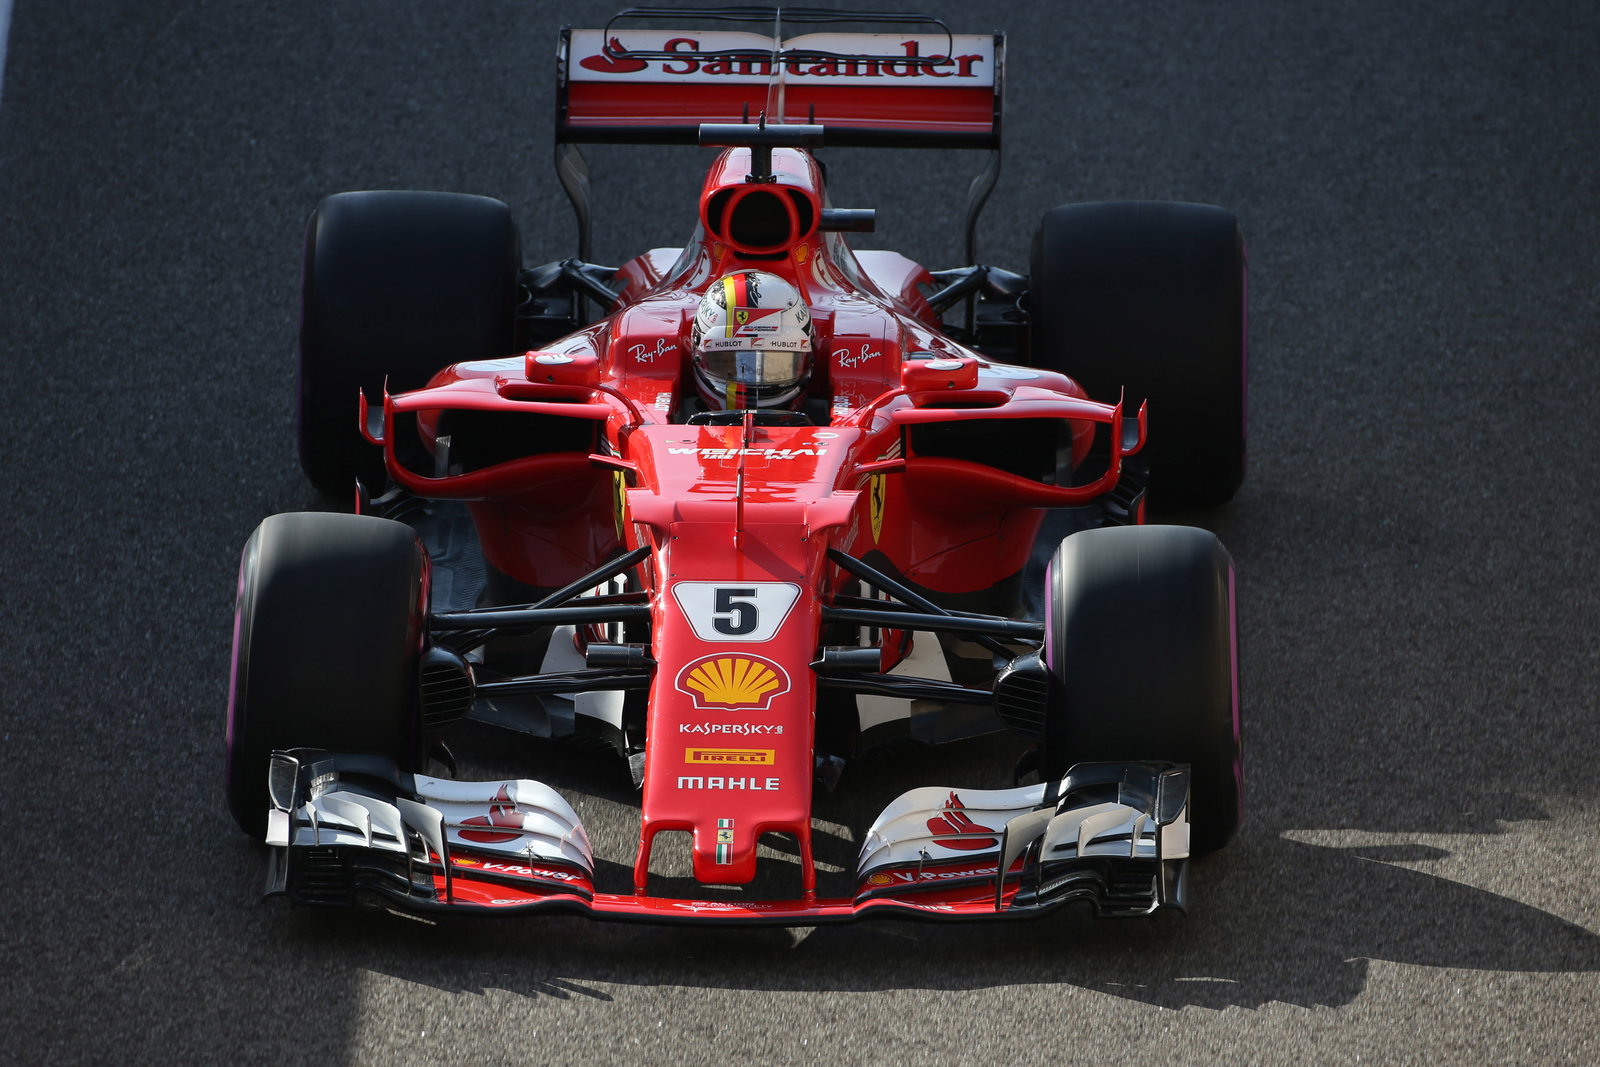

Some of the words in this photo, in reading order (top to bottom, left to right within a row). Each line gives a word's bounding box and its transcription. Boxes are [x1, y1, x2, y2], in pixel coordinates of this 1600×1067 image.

[662, 37, 984, 79] Santander
[715, 340, 742, 348] HUBLOT
[771, 340, 797, 348] HUBLOT
[667, 447, 828, 456] WEICHAI
[712, 587, 759, 636] 5
[679, 722, 775, 736] KASPERSKY
[693, 751, 768, 762] PIRELLI
[677, 776, 780, 790] MAHLE
